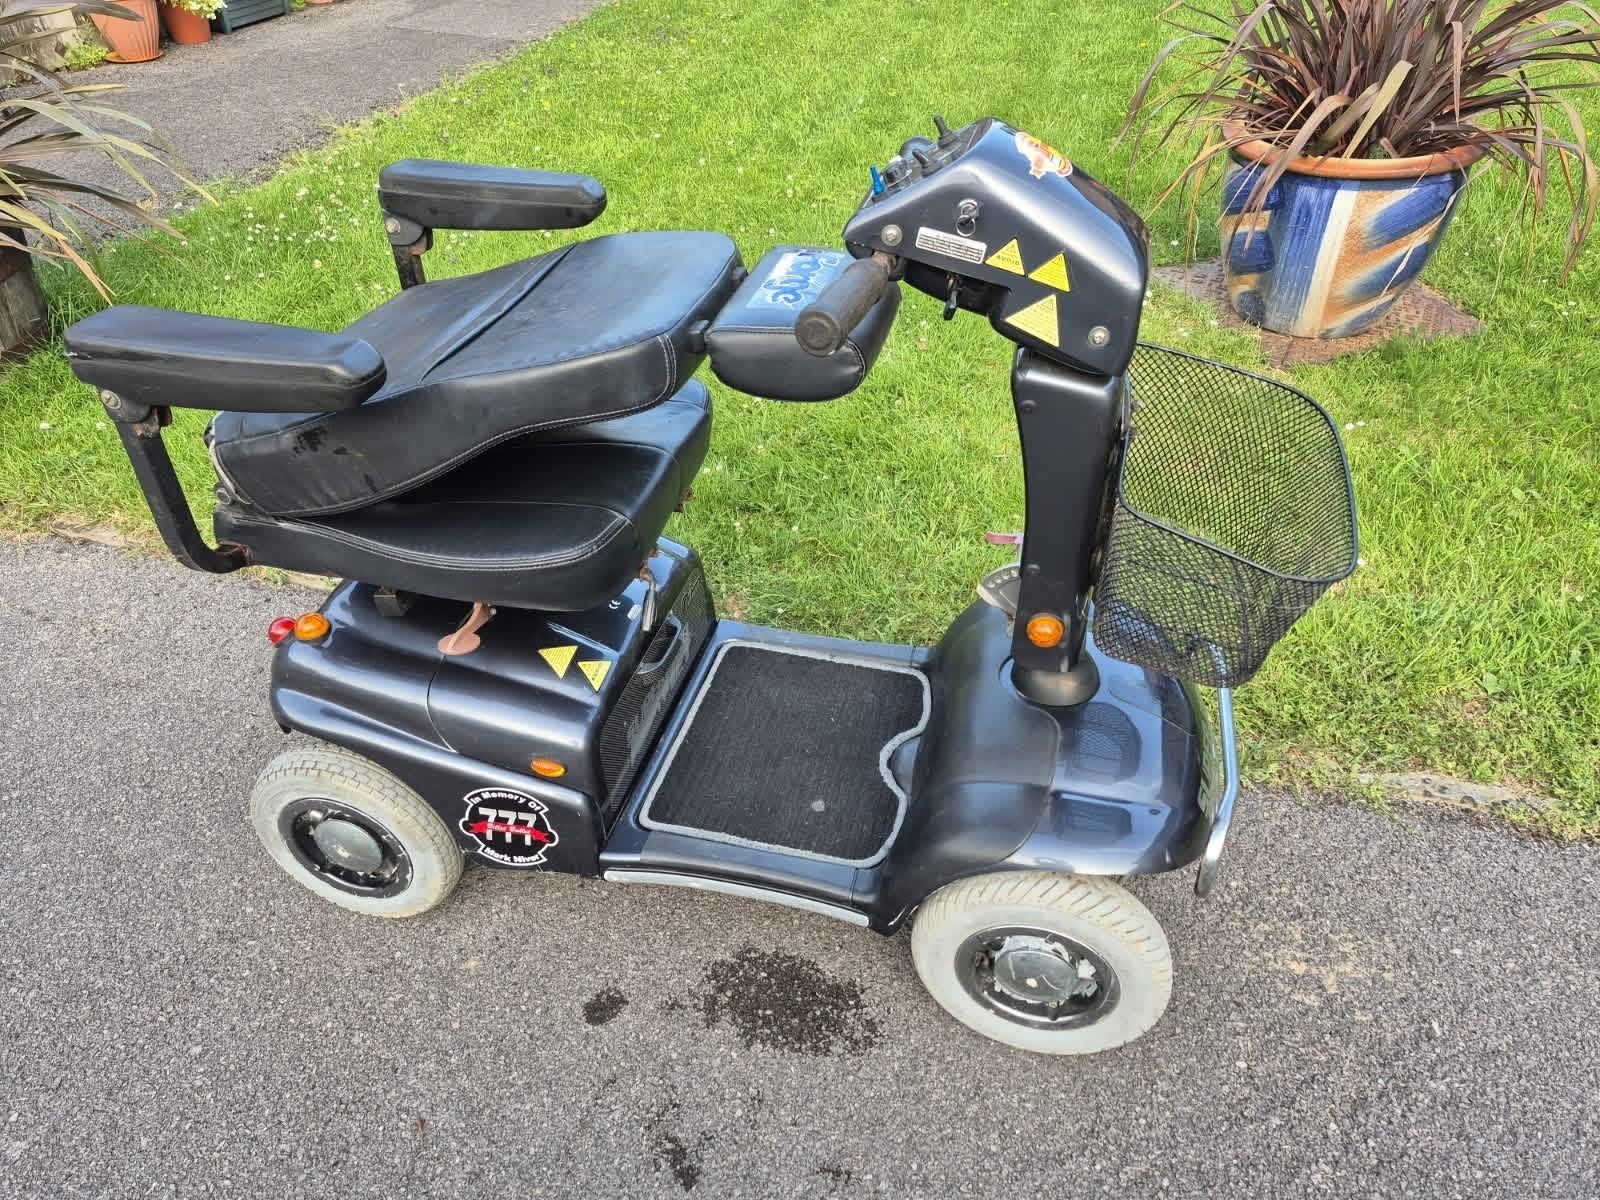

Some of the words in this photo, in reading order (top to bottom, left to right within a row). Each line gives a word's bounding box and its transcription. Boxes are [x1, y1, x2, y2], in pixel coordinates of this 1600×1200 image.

[470, 796, 482, 805] In
[481, 792, 526, 804] Memory
[528, 802, 542, 811] Of
[478, 807, 537, 846] 777
[484, 847, 511, 862] Mark
